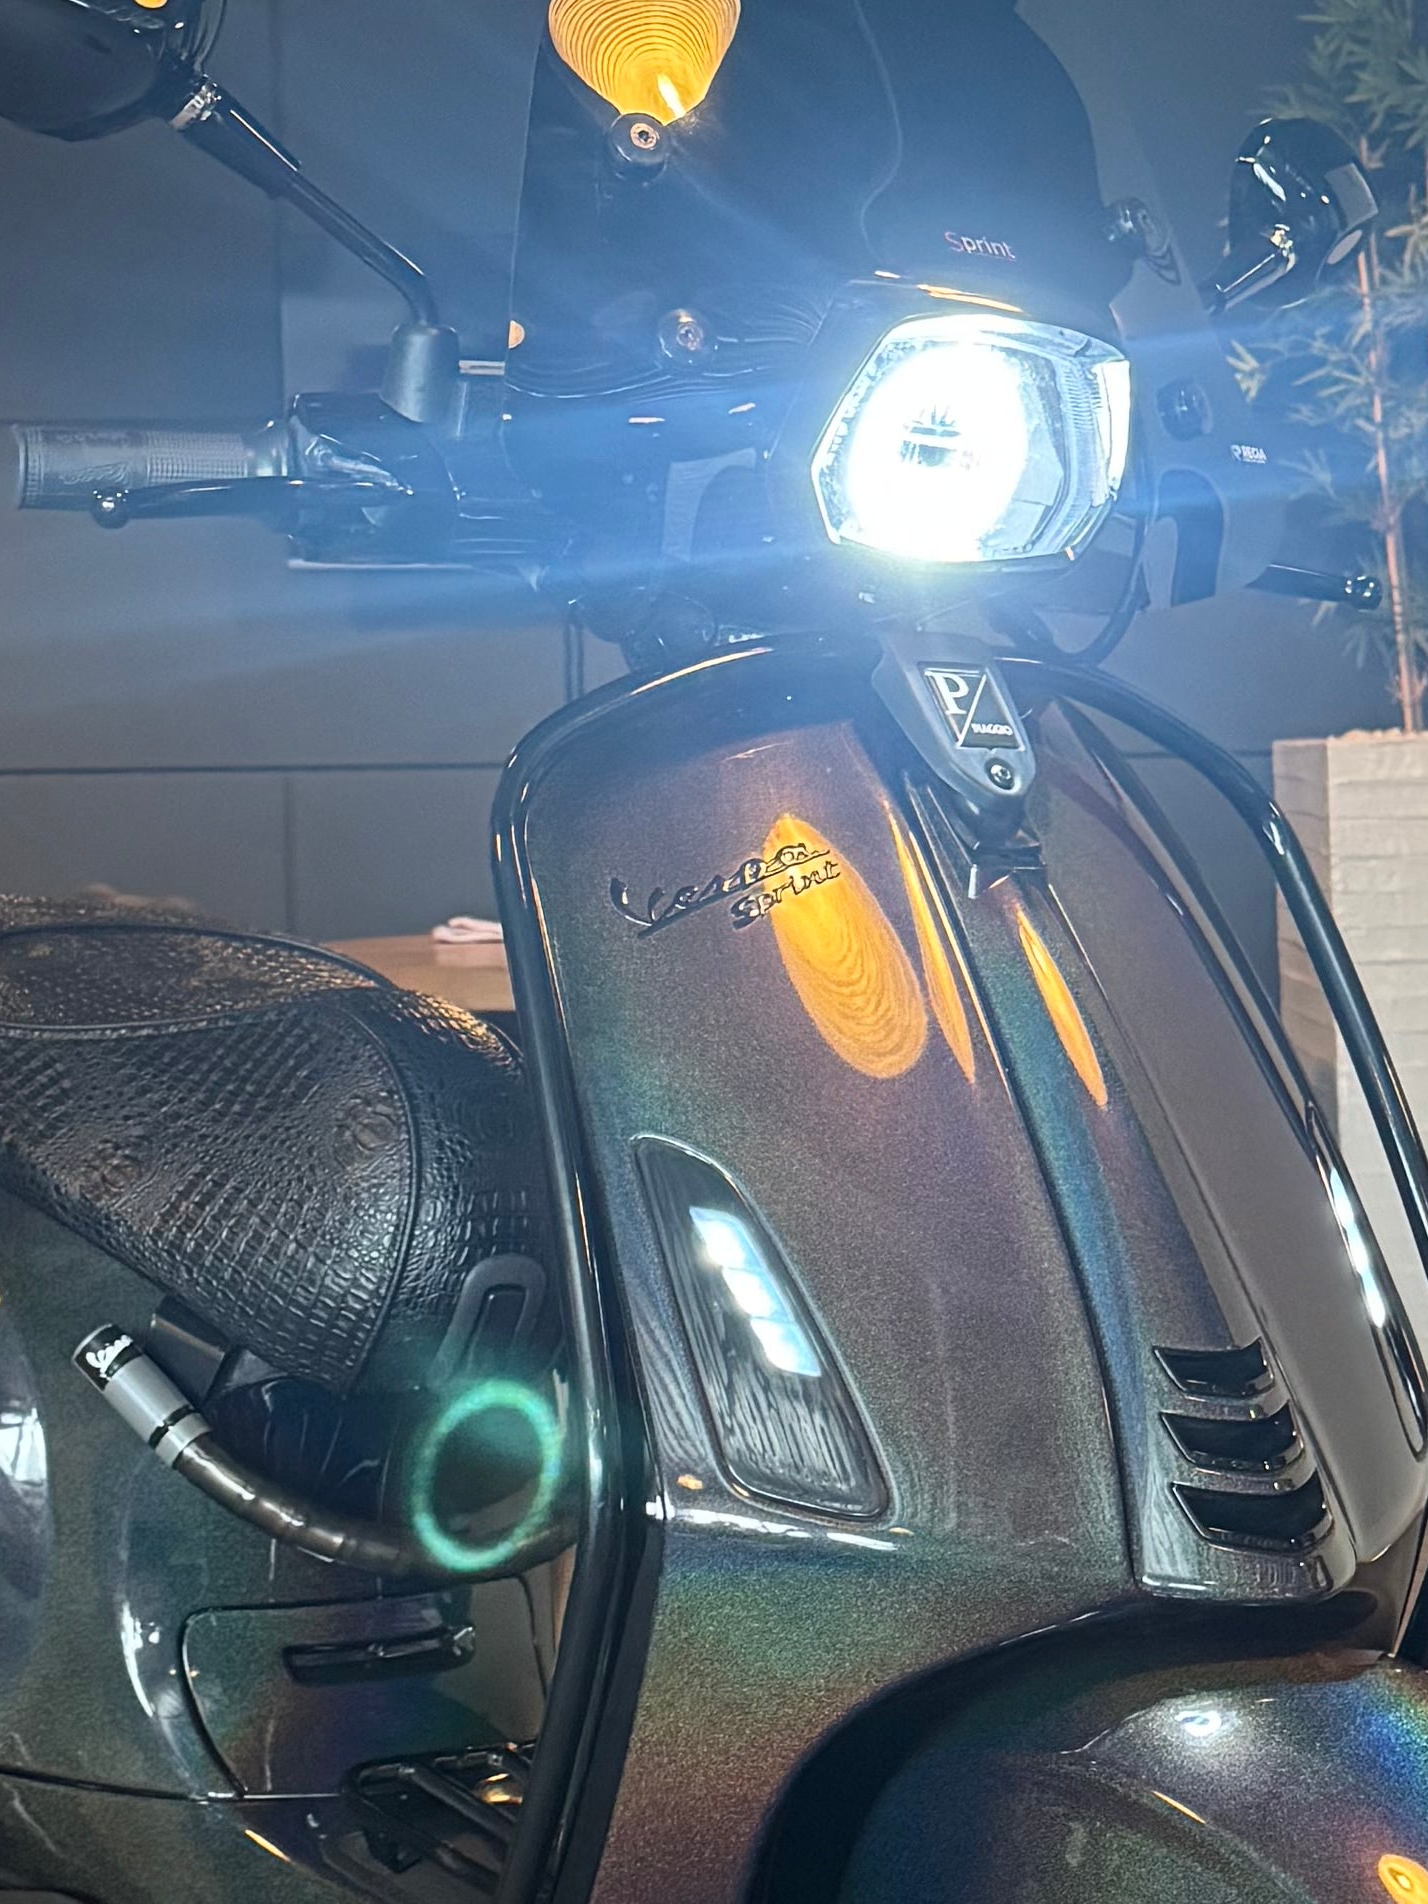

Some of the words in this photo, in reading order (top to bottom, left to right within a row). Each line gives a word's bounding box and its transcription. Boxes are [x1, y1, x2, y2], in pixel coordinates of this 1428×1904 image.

[944, 230, 1015, 259] Sprint
[924, 669, 969, 714] P
[609, 839, 831, 938] Vespa
[730, 860, 840, 930] Sprint
